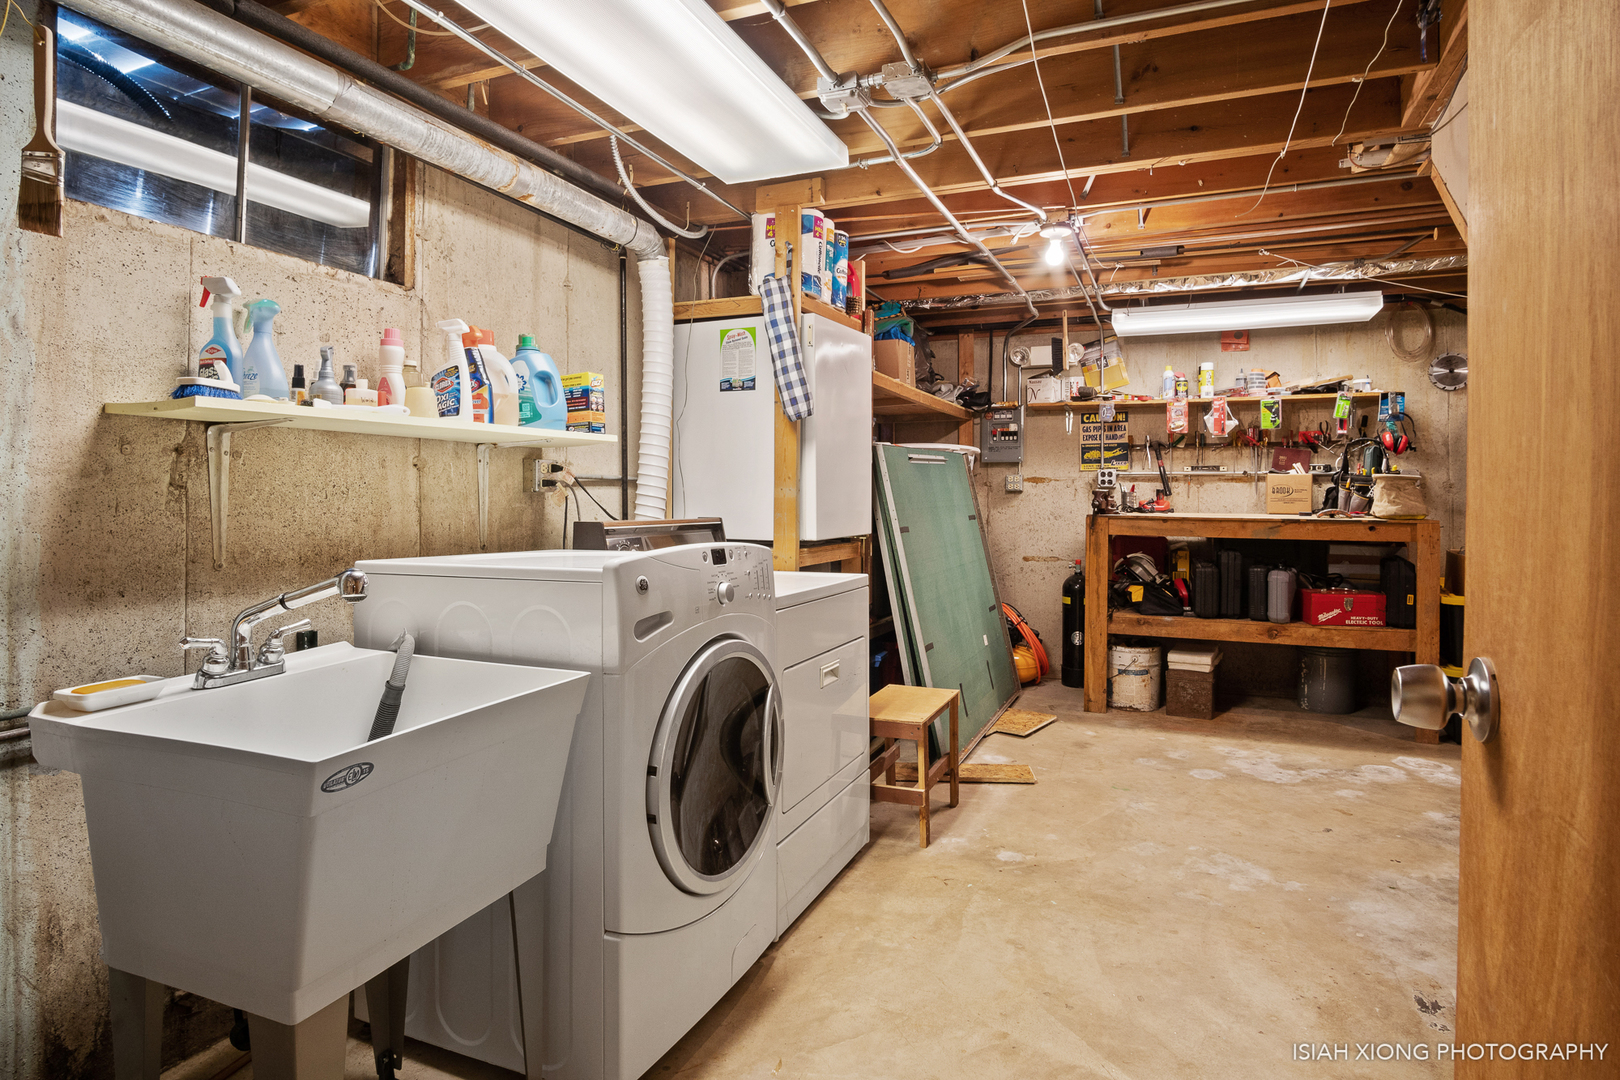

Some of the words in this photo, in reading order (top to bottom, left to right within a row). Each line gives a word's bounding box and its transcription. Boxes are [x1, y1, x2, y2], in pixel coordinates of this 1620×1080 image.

[437, 398, 455, 410] AGIC
[1083, 412, 1126, 423] CAUON!
[1082, 425, 1092, 433] GAS
[1093, 425, 1106, 433] PIPS
[1114, 424, 1127, 432] AREA
[1105, 433, 1118, 441] HAND
